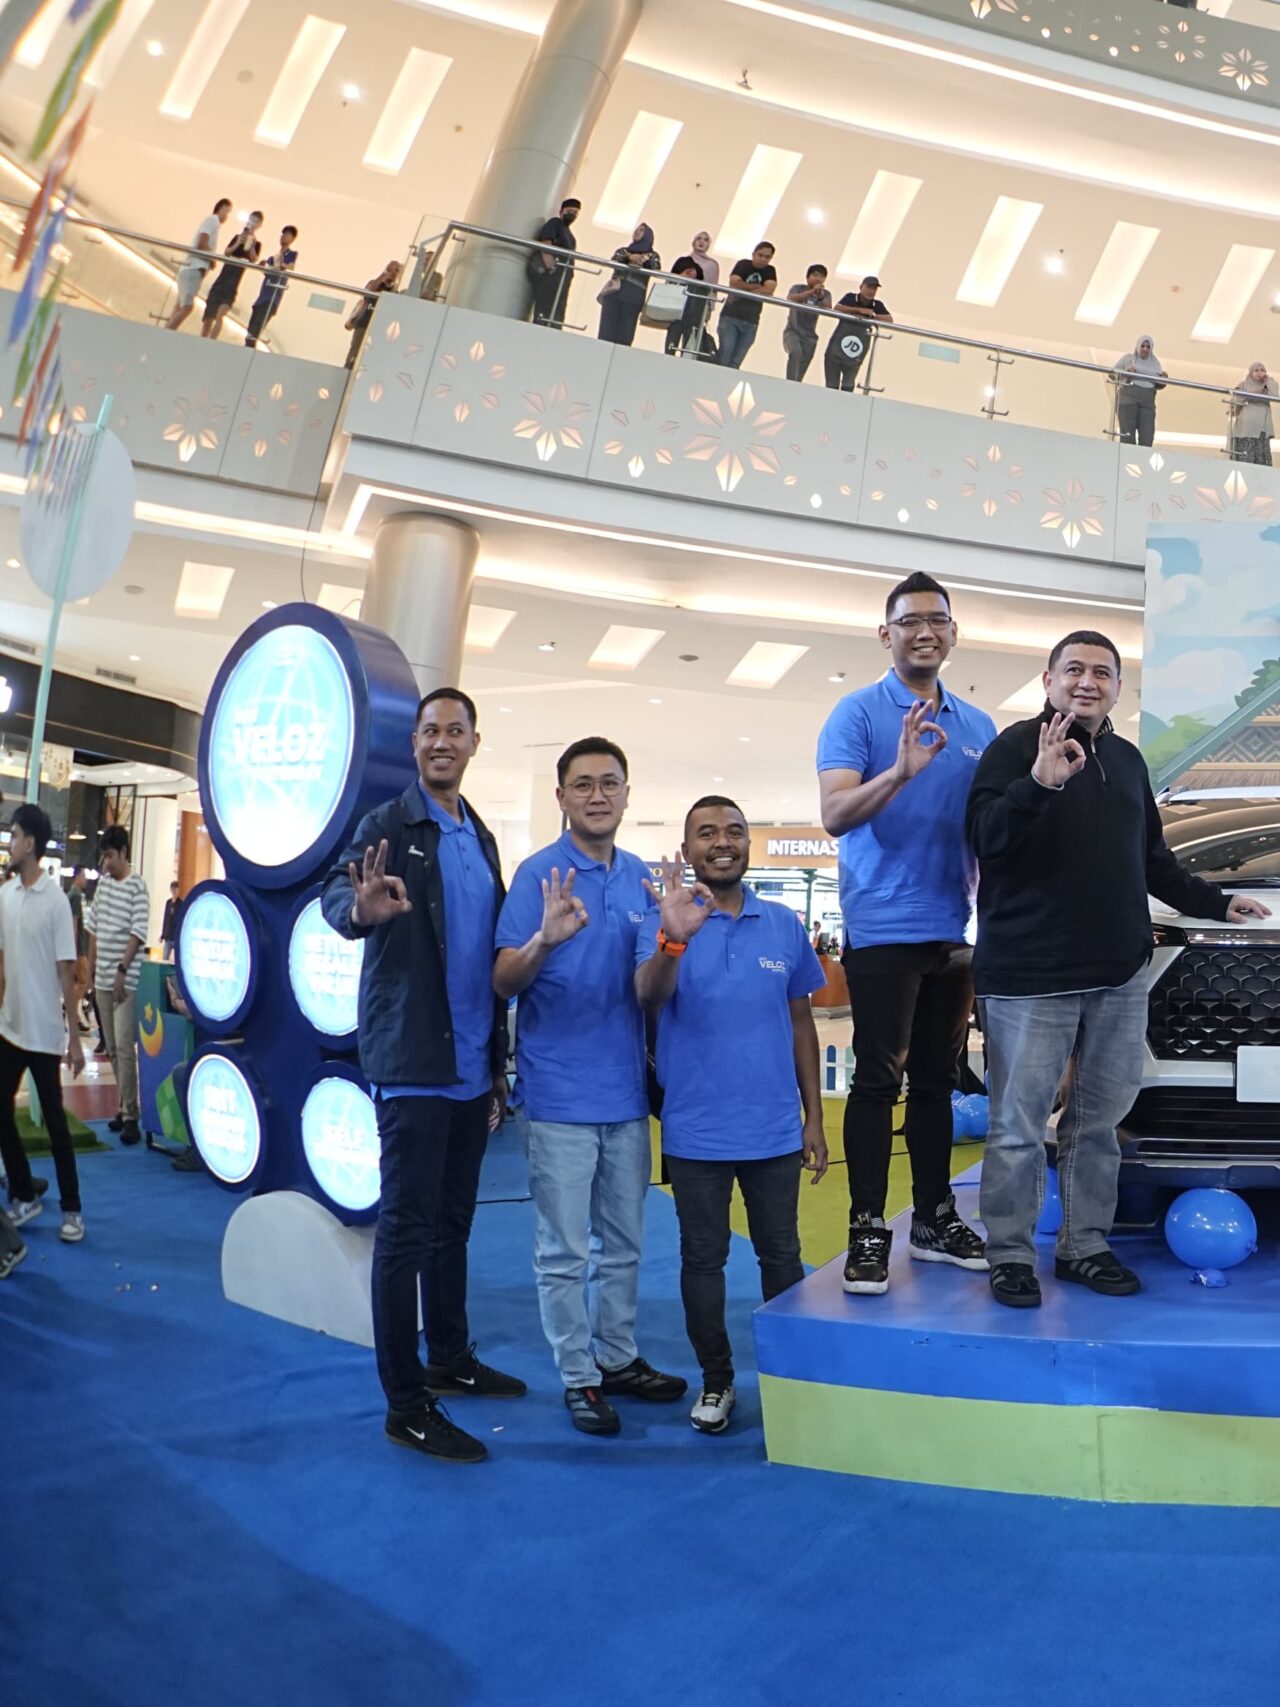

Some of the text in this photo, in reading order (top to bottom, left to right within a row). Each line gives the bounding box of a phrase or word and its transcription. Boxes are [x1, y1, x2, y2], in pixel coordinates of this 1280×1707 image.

[843, 340, 860, 353] JD
[233, 723, 326, 764] VELOZ
[767, 839, 840, 856] INTERNAS
